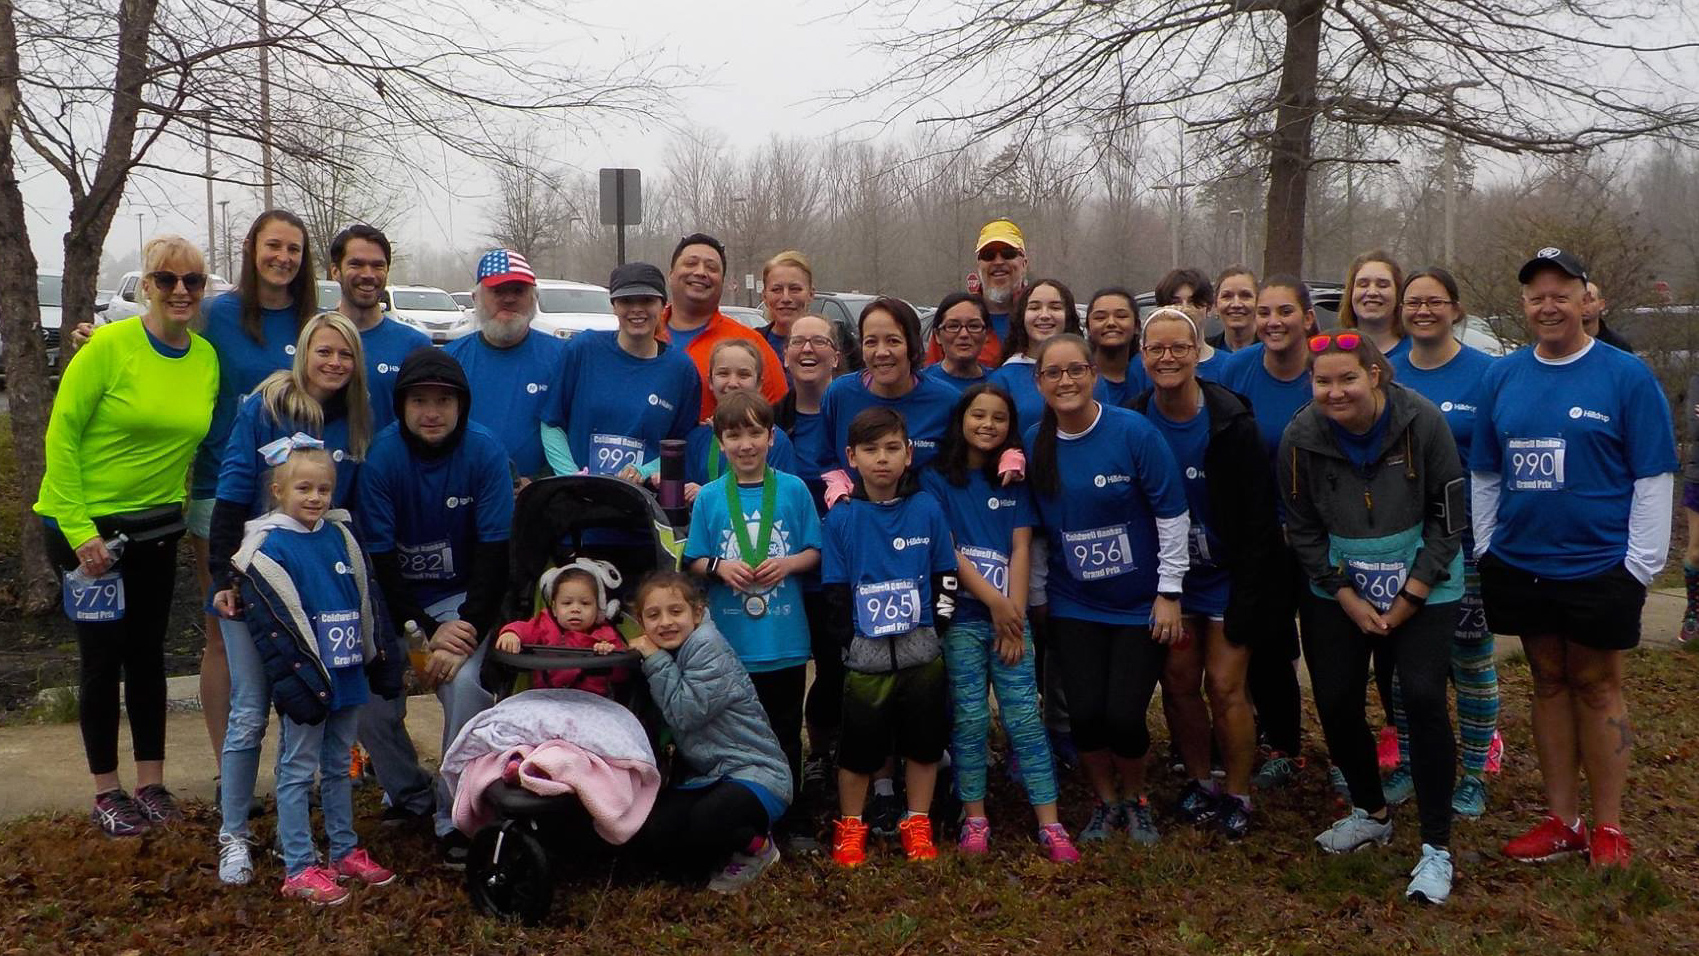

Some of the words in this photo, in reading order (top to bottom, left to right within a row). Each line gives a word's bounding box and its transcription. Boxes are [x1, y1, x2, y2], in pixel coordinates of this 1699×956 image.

[1583, 410, 1610, 423] Hilldrup
[1512, 452, 1555, 476] 990
[1516, 480, 1536, 488] Grand
[1537, 480, 1552, 488] Prix
[906, 537, 930, 546] Hilldrup
[1065, 531, 1096, 542] Coldwell
[398, 553, 443, 571] 982
[1074, 540, 1121, 568] 956
[1355, 573, 1400, 598] 960
[72, 584, 117, 607] 979
[867, 594, 914, 622] 965
[1459, 607, 1486, 628] 73
[873, 622, 896, 634] Grand
